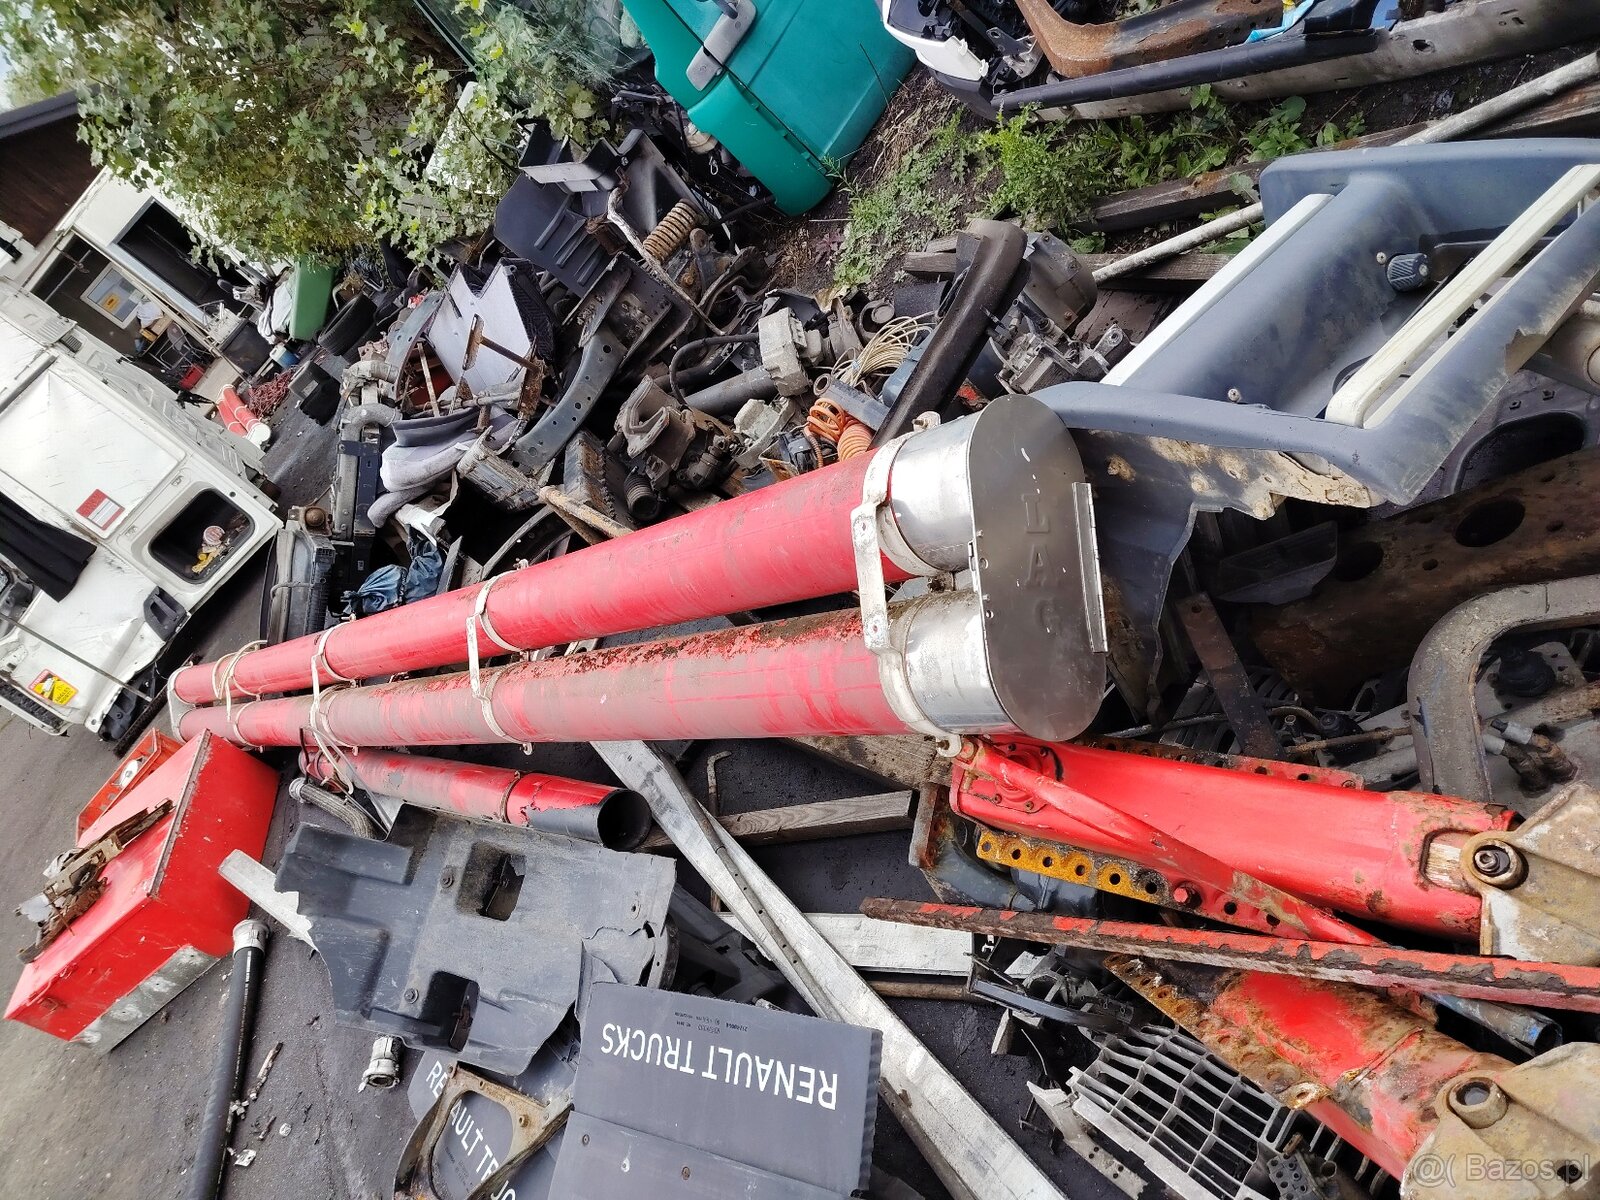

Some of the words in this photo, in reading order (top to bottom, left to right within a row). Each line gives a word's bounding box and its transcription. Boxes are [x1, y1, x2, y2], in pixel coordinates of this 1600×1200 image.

[601, 1023, 695, 1074] TRUCKS
[701, 1045, 838, 1110] RENAULT
[426, 1060, 484, 1156] REAULT
